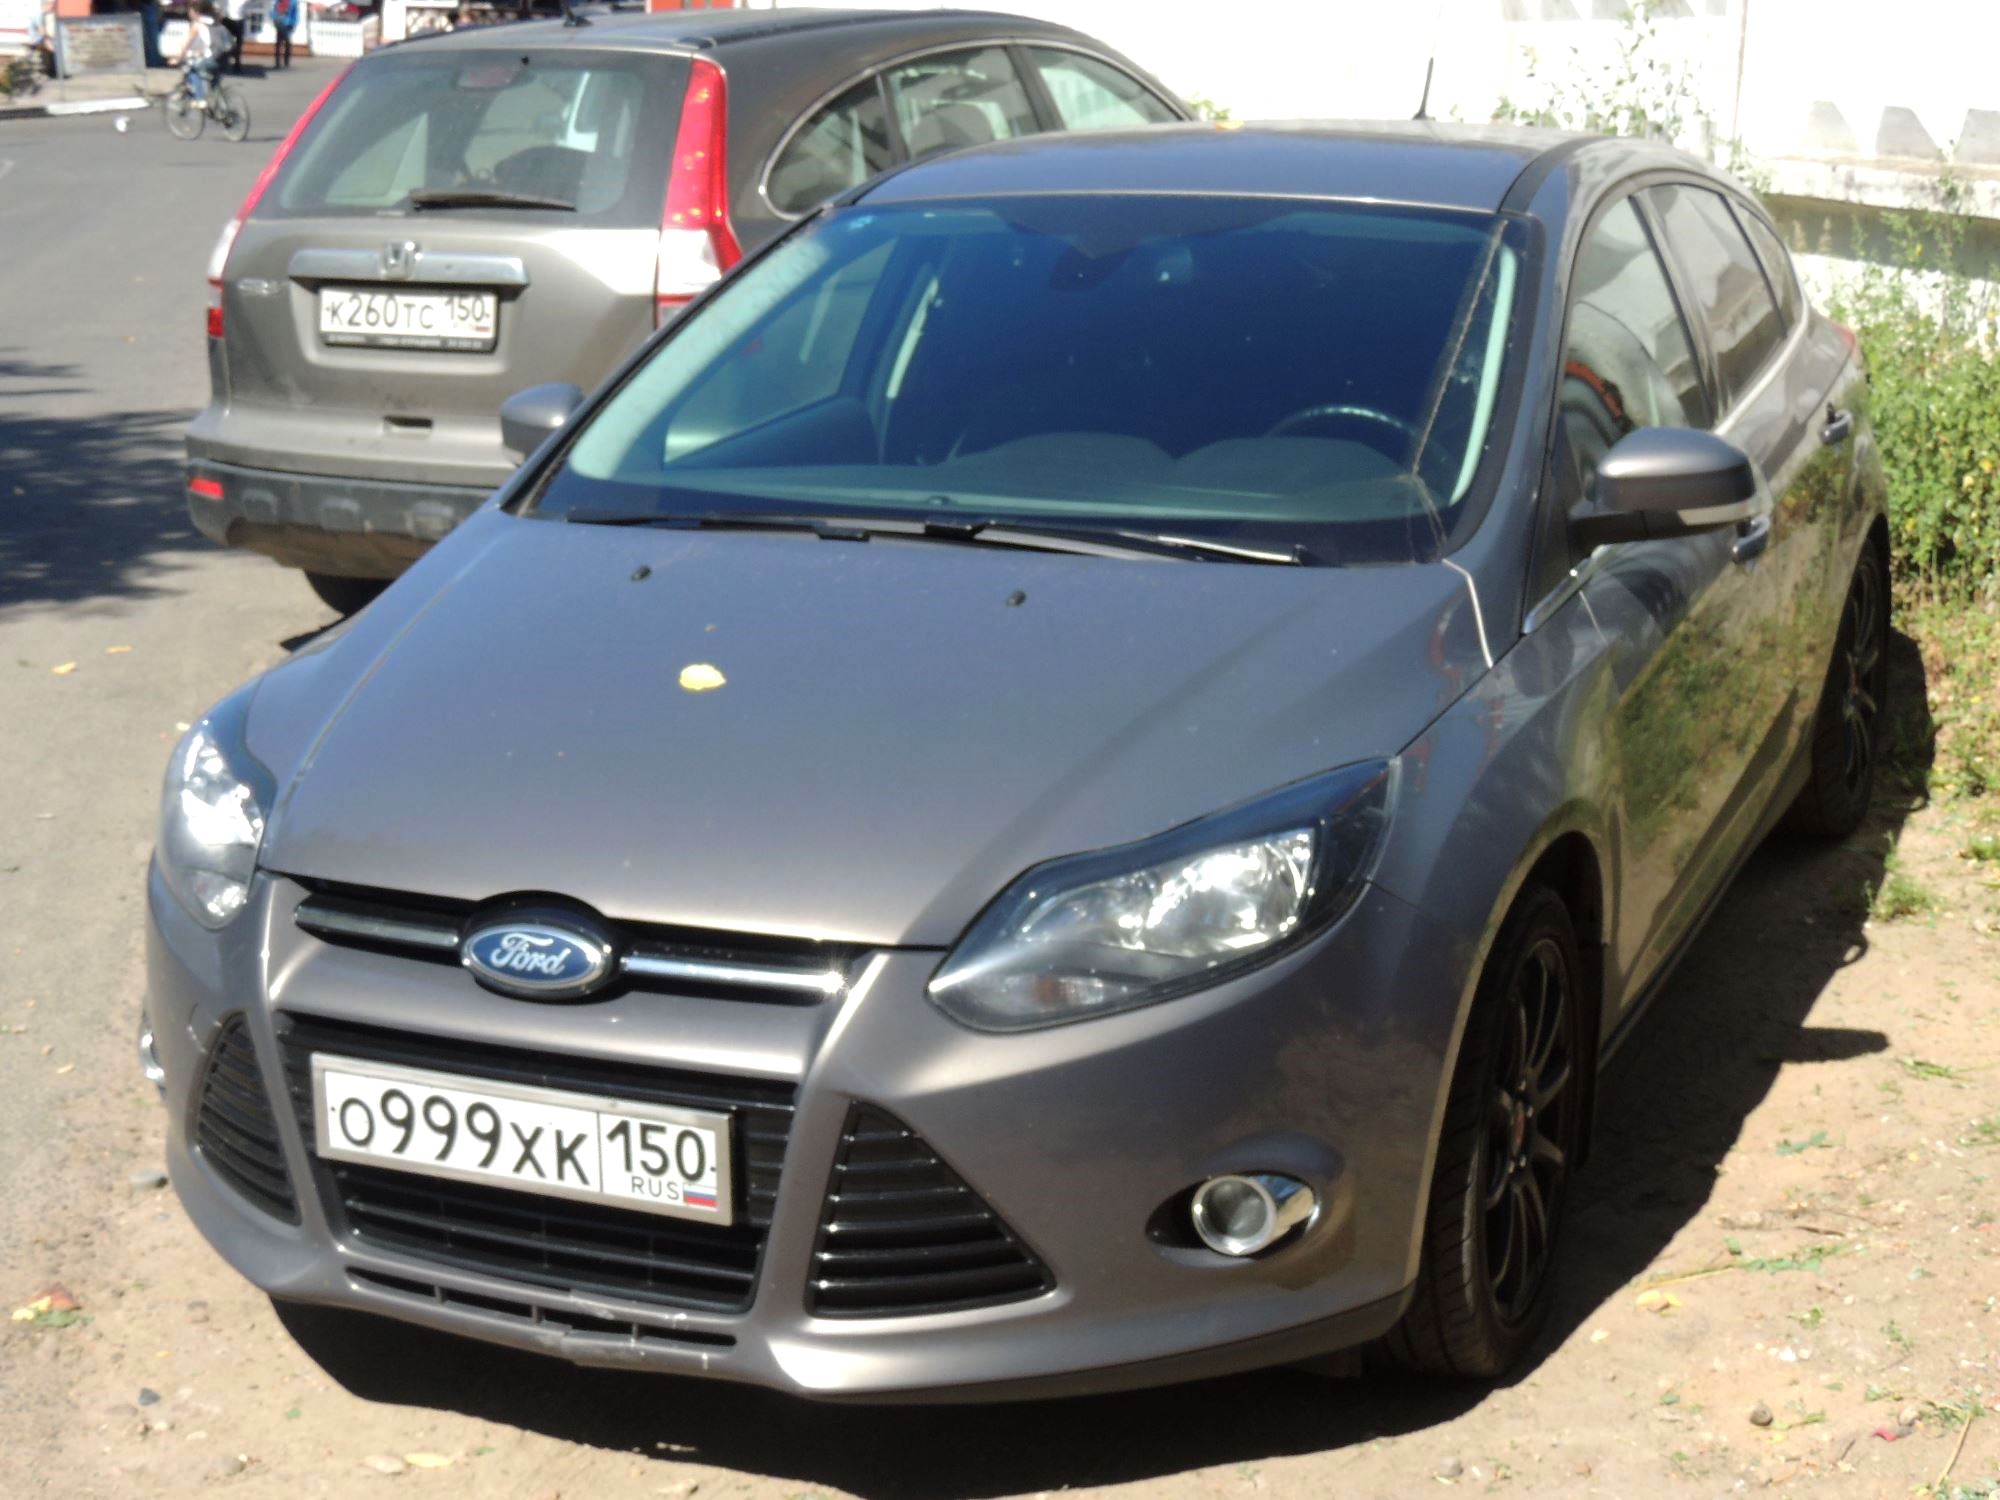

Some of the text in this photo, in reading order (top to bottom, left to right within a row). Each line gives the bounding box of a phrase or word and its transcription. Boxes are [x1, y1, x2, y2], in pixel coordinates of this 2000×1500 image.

[491, 933, 571, 975] Ford
[606, 1120, 706, 1182] 150
[631, 1175, 680, 1201] RUS
